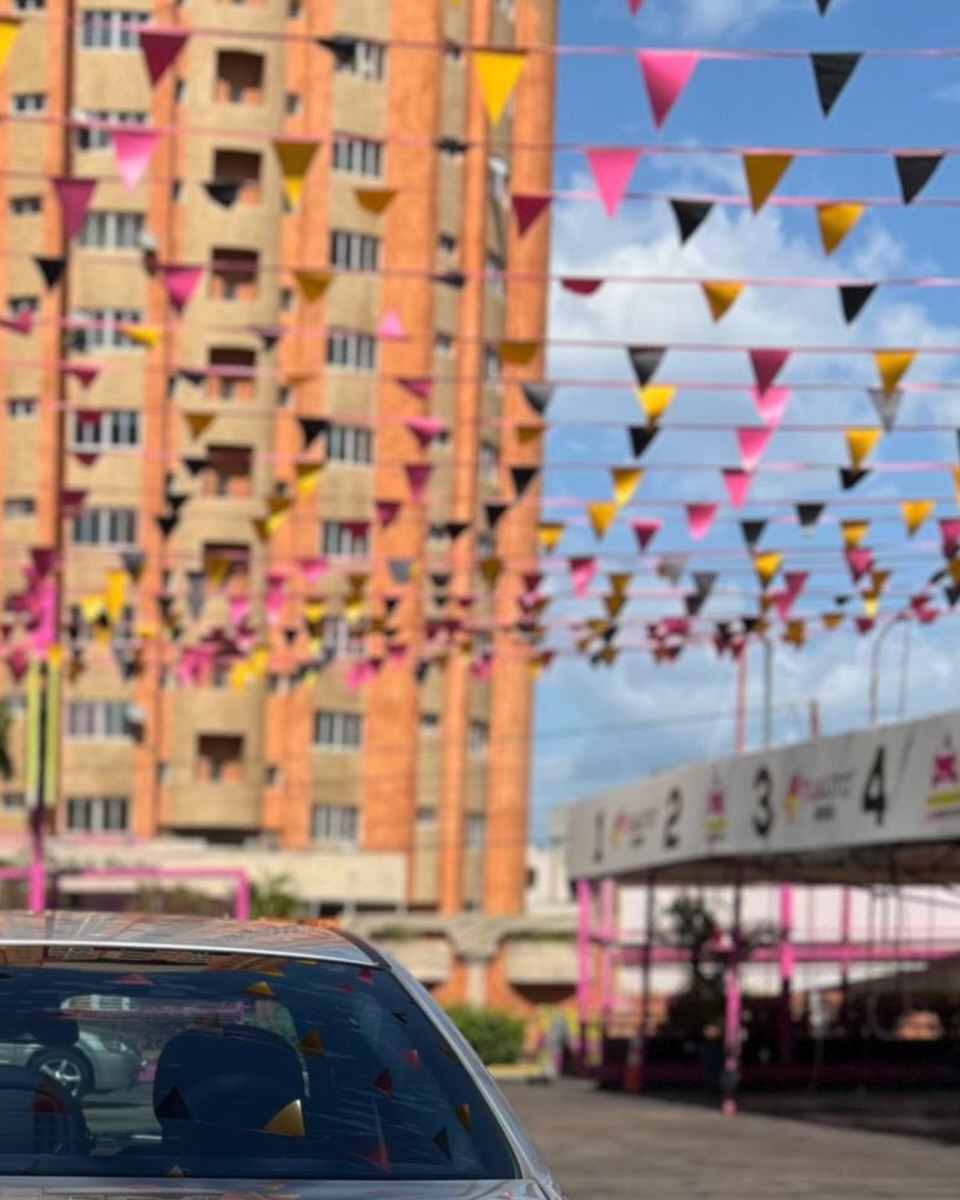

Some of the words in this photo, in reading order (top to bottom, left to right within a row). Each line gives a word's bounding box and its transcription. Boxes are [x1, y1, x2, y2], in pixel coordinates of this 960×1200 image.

[664, 785, 685, 850] 2
[751, 765, 774, 837] 3
[861, 743, 887, 827] 4
